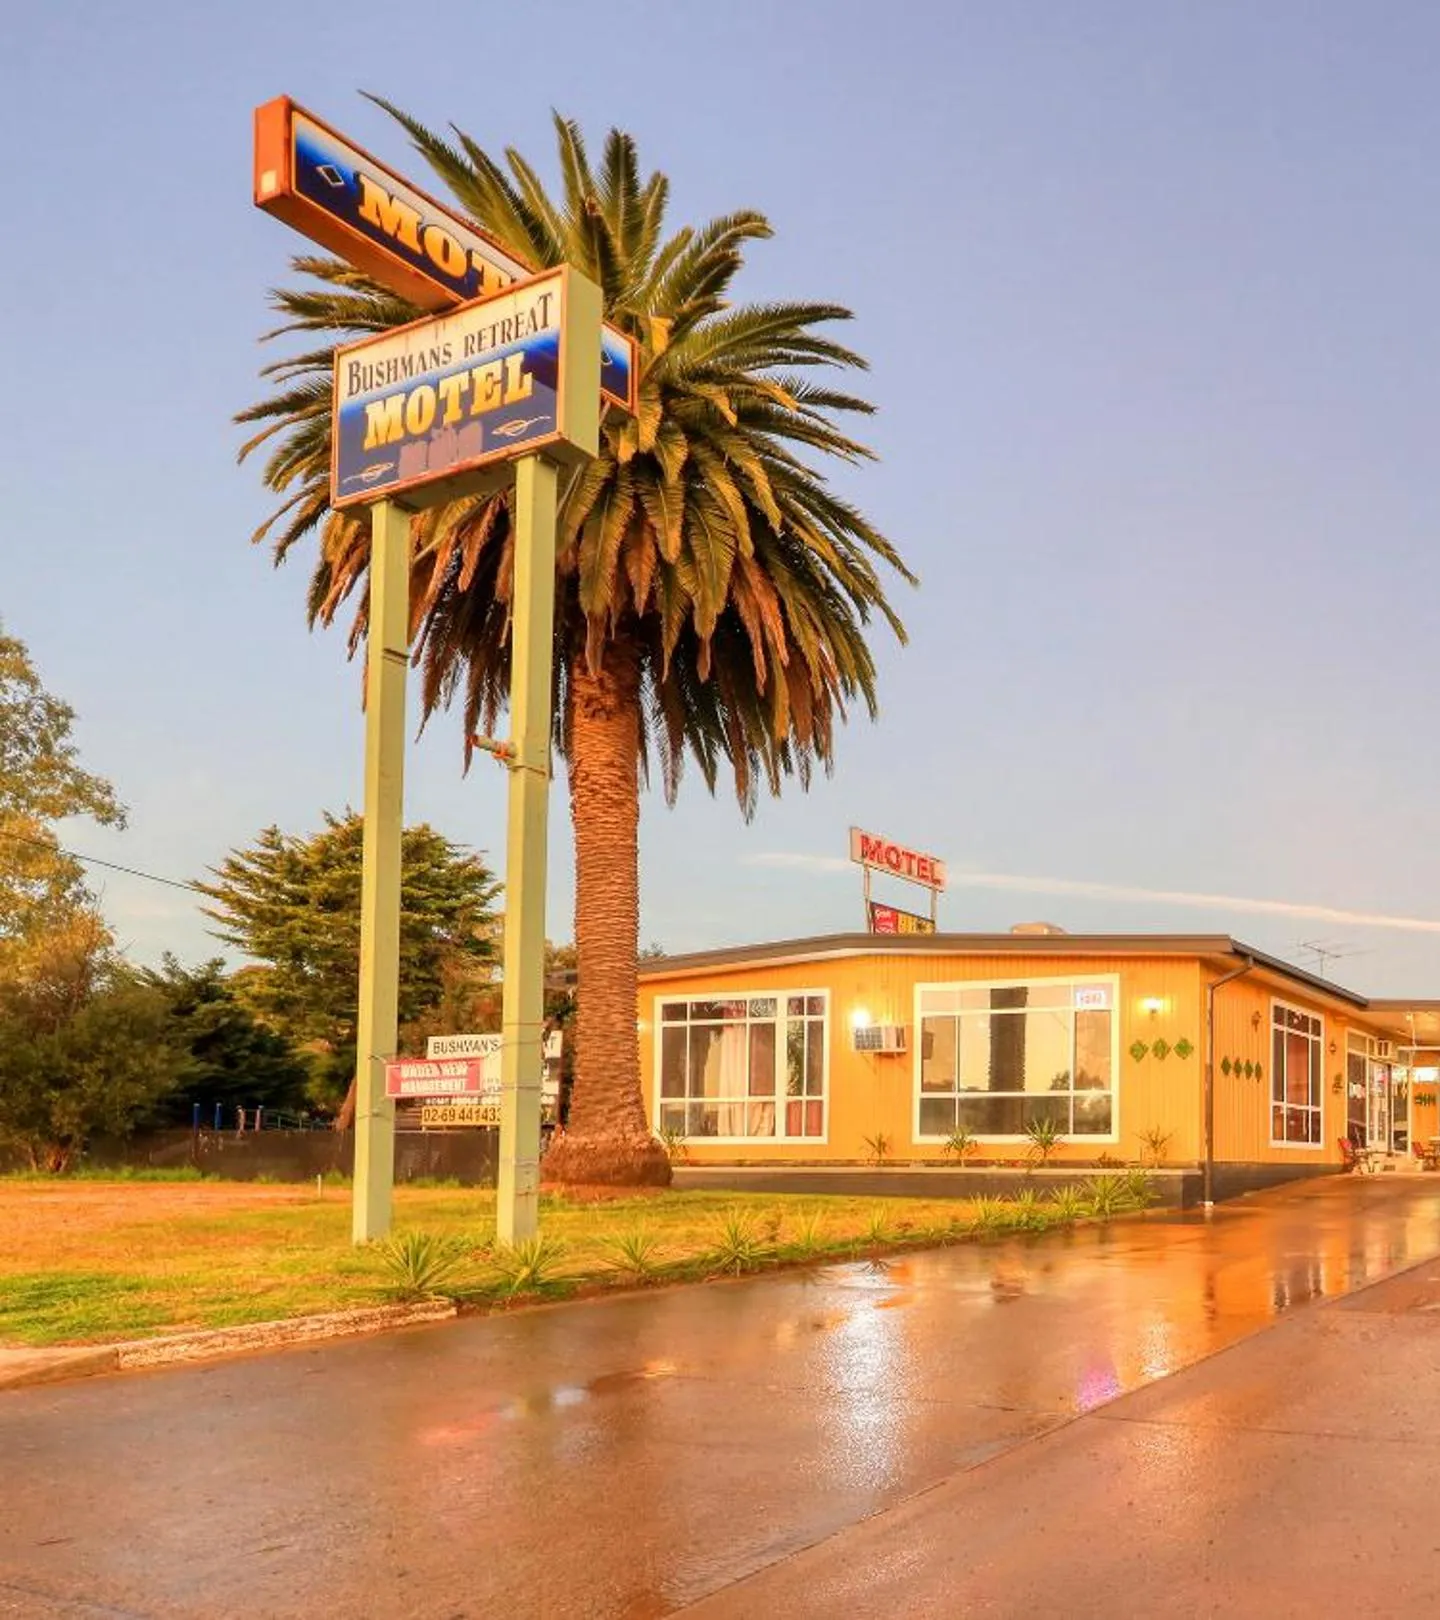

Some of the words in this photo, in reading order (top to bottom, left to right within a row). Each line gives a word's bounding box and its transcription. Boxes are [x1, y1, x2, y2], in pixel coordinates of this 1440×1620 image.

[346, 342, 453, 397] BUSHMANS
[463, 291, 554, 357] RETREAT
[363, 352, 533, 451] MOTEL
[860, 834, 942, 886] MOTEL
[432, 1037, 501, 1055] BUSHMAN'S
